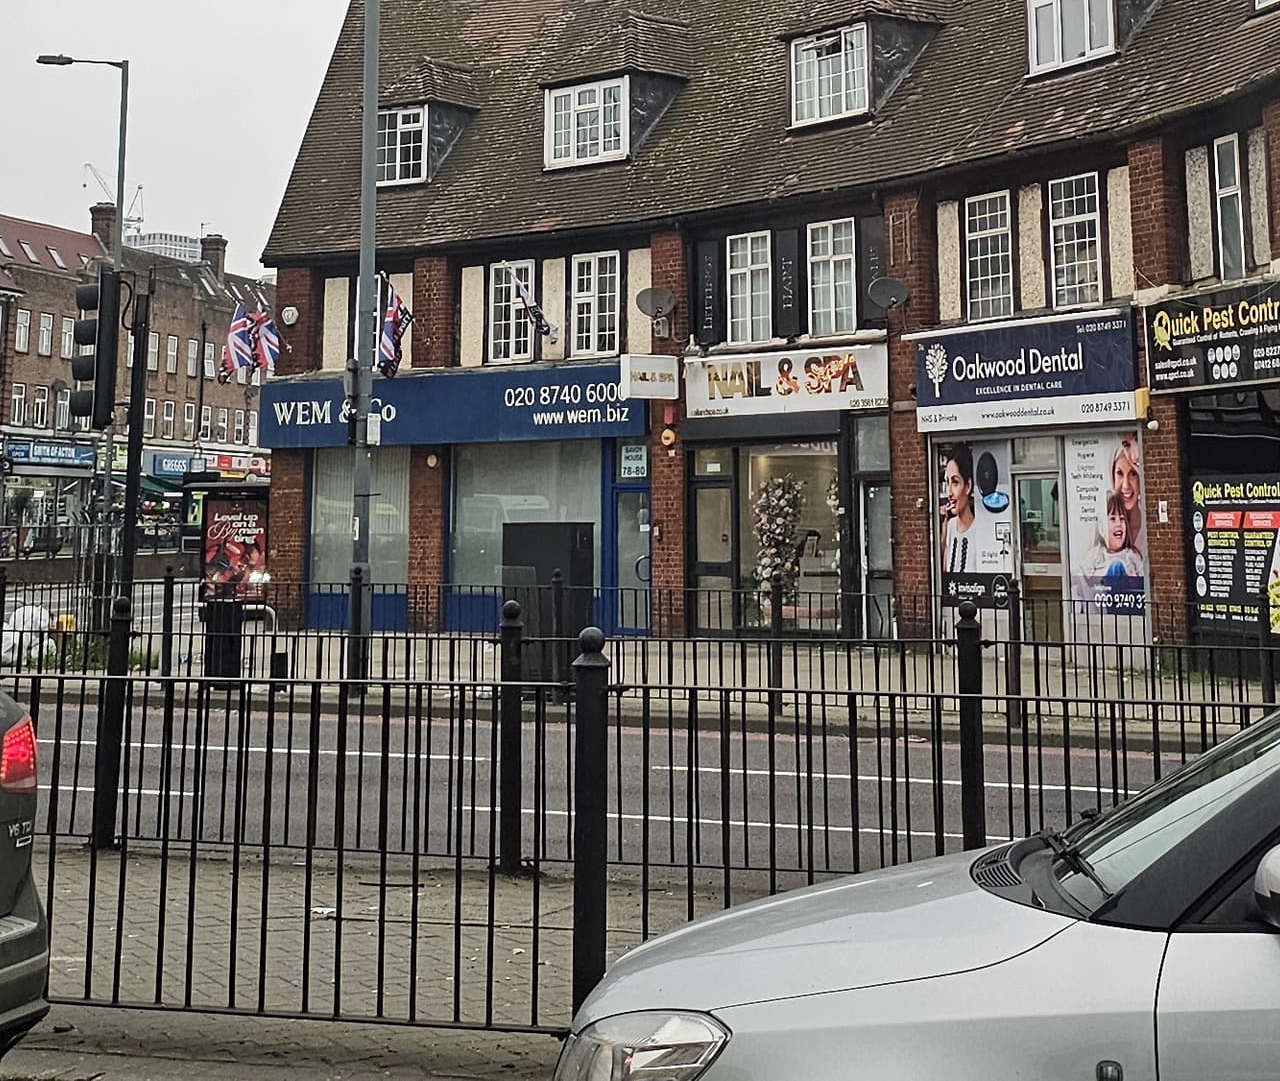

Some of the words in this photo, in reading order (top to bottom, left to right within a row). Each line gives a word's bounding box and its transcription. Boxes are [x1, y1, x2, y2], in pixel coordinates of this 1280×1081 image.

[1153, 310, 1200, 351] Quick
[1203, 304, 1235, 331] Pest
[952, 348, 1026, 381] Oakwood
[1029, 342, 1084, 374] Dental
[707, 360, 772, 400] NAIL
[776, 357, 800, 396] &
[804, 353, 864, 395] SPA
[505, 388, 535, 406] 020
[540, 385, 581, 405] 8740
[975, 385, 1012, 396] EXCELLENCE
[1012, 384, 1020, 392] IN
[1021, 382, 1045, 392] DENTAL
[1046, 380, 1063, 390] CARE
[273, 400, 332, 426] WEM
[1081, 404, 1094, 414] 020
[162, 458, 187, 472] GREGGS
[1224, 482, 1244, 498] Pest
[1246, 481, 1280, 498] Control
[214, 513, 242, 521] Level
